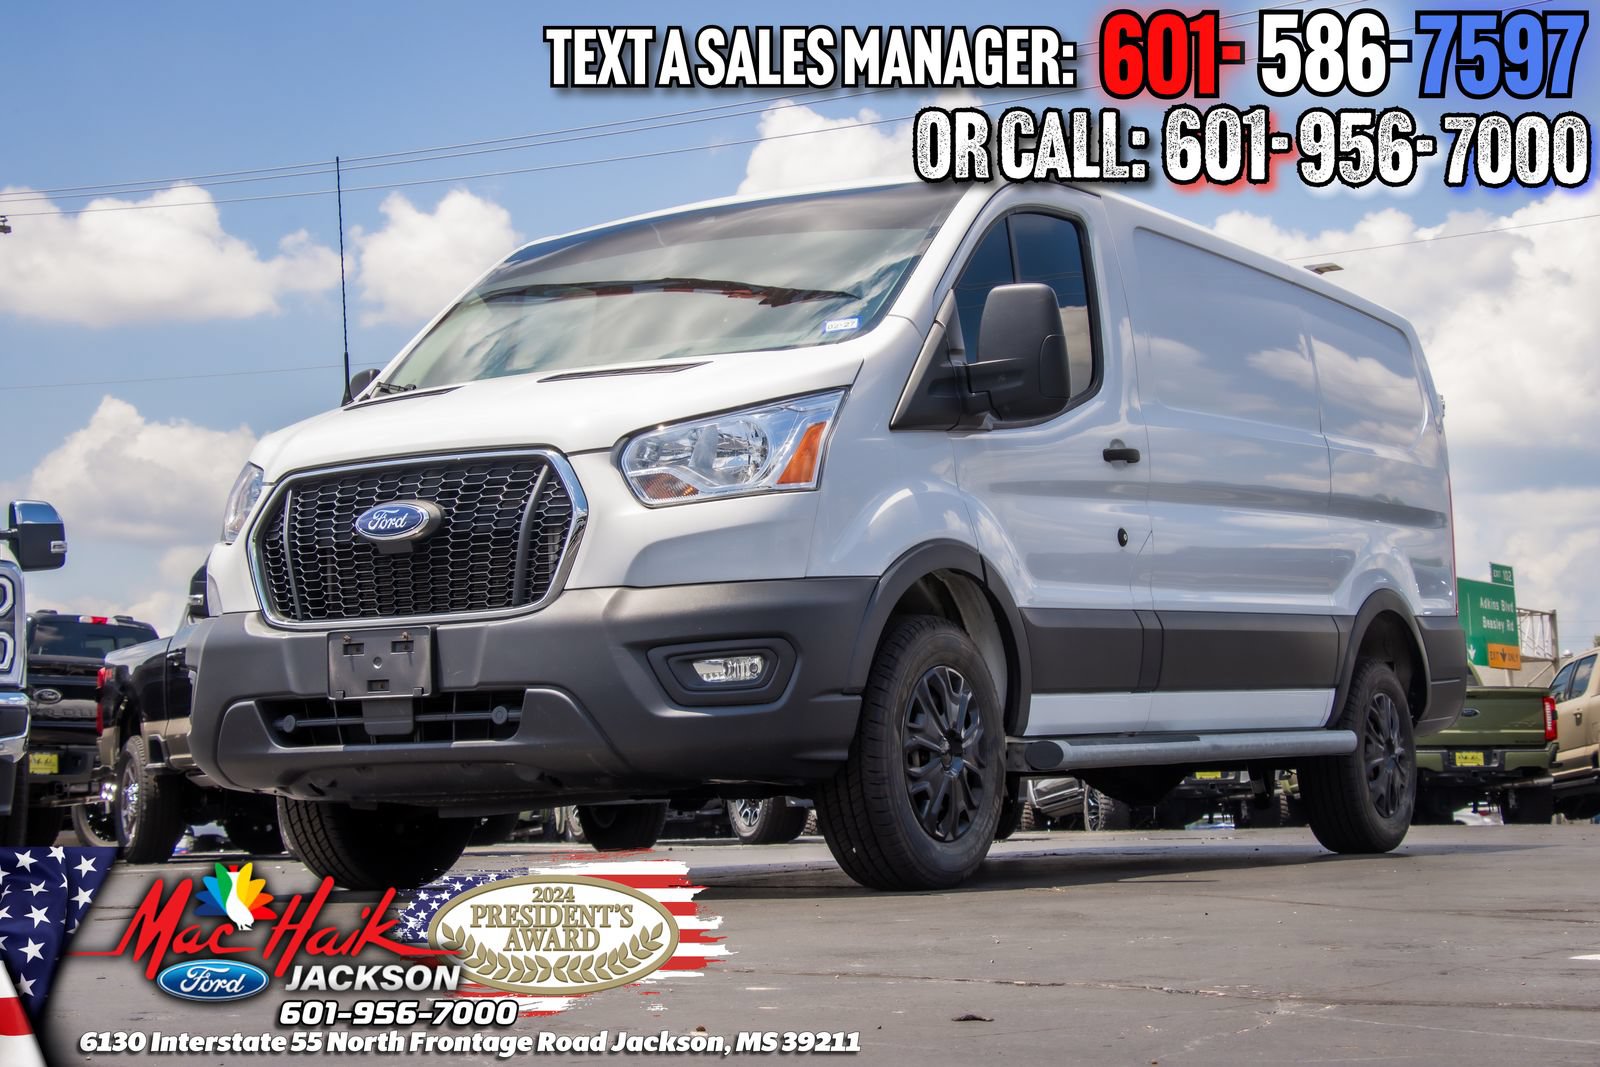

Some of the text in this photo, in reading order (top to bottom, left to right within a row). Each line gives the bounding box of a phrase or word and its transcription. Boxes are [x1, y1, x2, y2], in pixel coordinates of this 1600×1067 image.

[367, 508, 409, 531] Ford
[1479, 596, 1514, 613] Adkins Blvd
[1482, 615, 1514, 634] Beasley Rd
